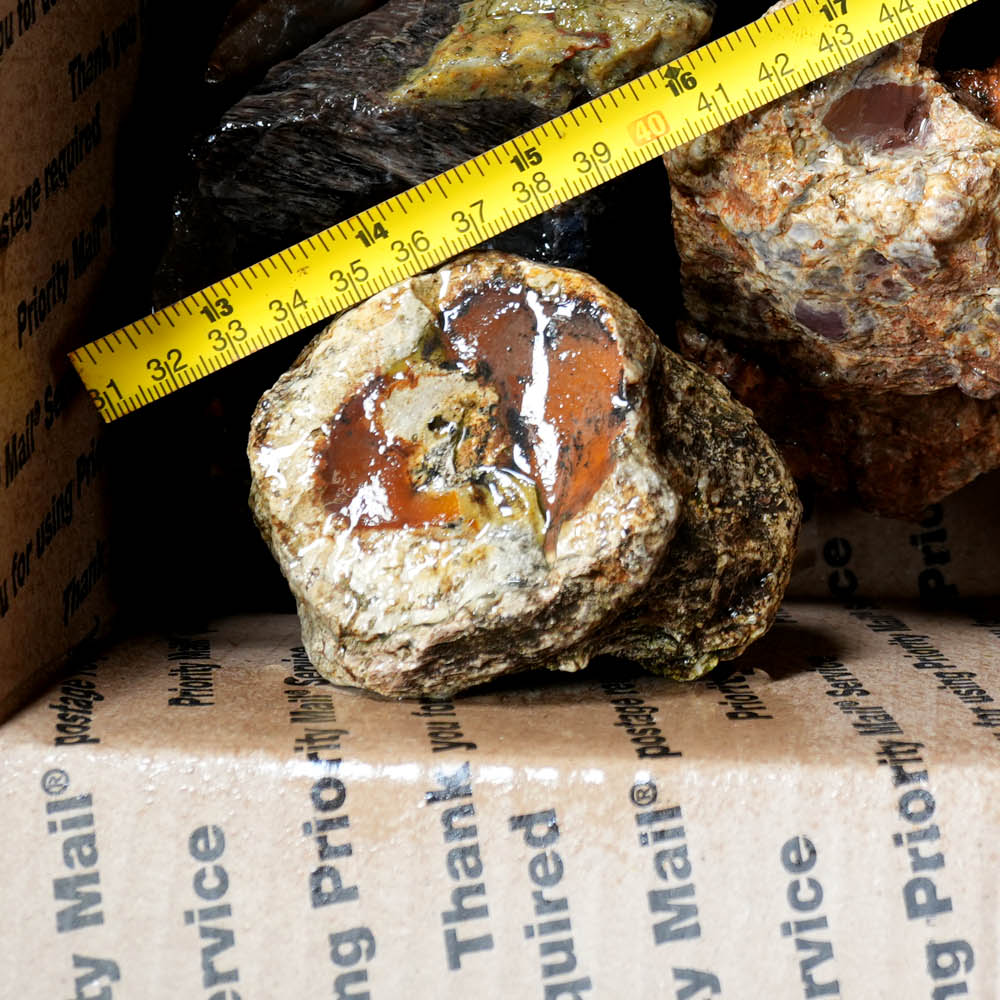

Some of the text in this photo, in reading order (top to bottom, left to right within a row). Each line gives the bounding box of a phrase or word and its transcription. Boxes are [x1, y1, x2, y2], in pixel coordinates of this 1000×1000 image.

[88, 379, 124, 410] 31
[146, 348, 188, 382] 32
[207, 319, 249, 352] 33
[268, 289, 308, 322] 34
[329, 259, 370, 293] 35
[390, 230, 430, 262] 36
[450, 200, 486, 234] 37
[512, 171, 552, 204] 38
[572, 142, 612, 174] 39
[632, 114, 669, 144] 40
[697, 83, 731, 113] 41
[758, 53, 794, 84] 42
[818, 23, 854, 54] 43
[200, 298, 233, 324] 13
[355, 222, 389, 248] 14
[511, 146, 543, 173] 15
[665, 71, 697, 97] 16
[17, 259, 69, 350] Priority
[49, 677, 105, 748] postage
[168, 663, 222, 707] Priority
[610, 697, 684, 760] postage
[41, 767, 105, 934] Mail®
[293, 727, 360, 909] Priority
[424, 722, 495, 971] Thank you
[630, 779, 701, 946] Mail®
[875, 739, 953, 920] Priority
